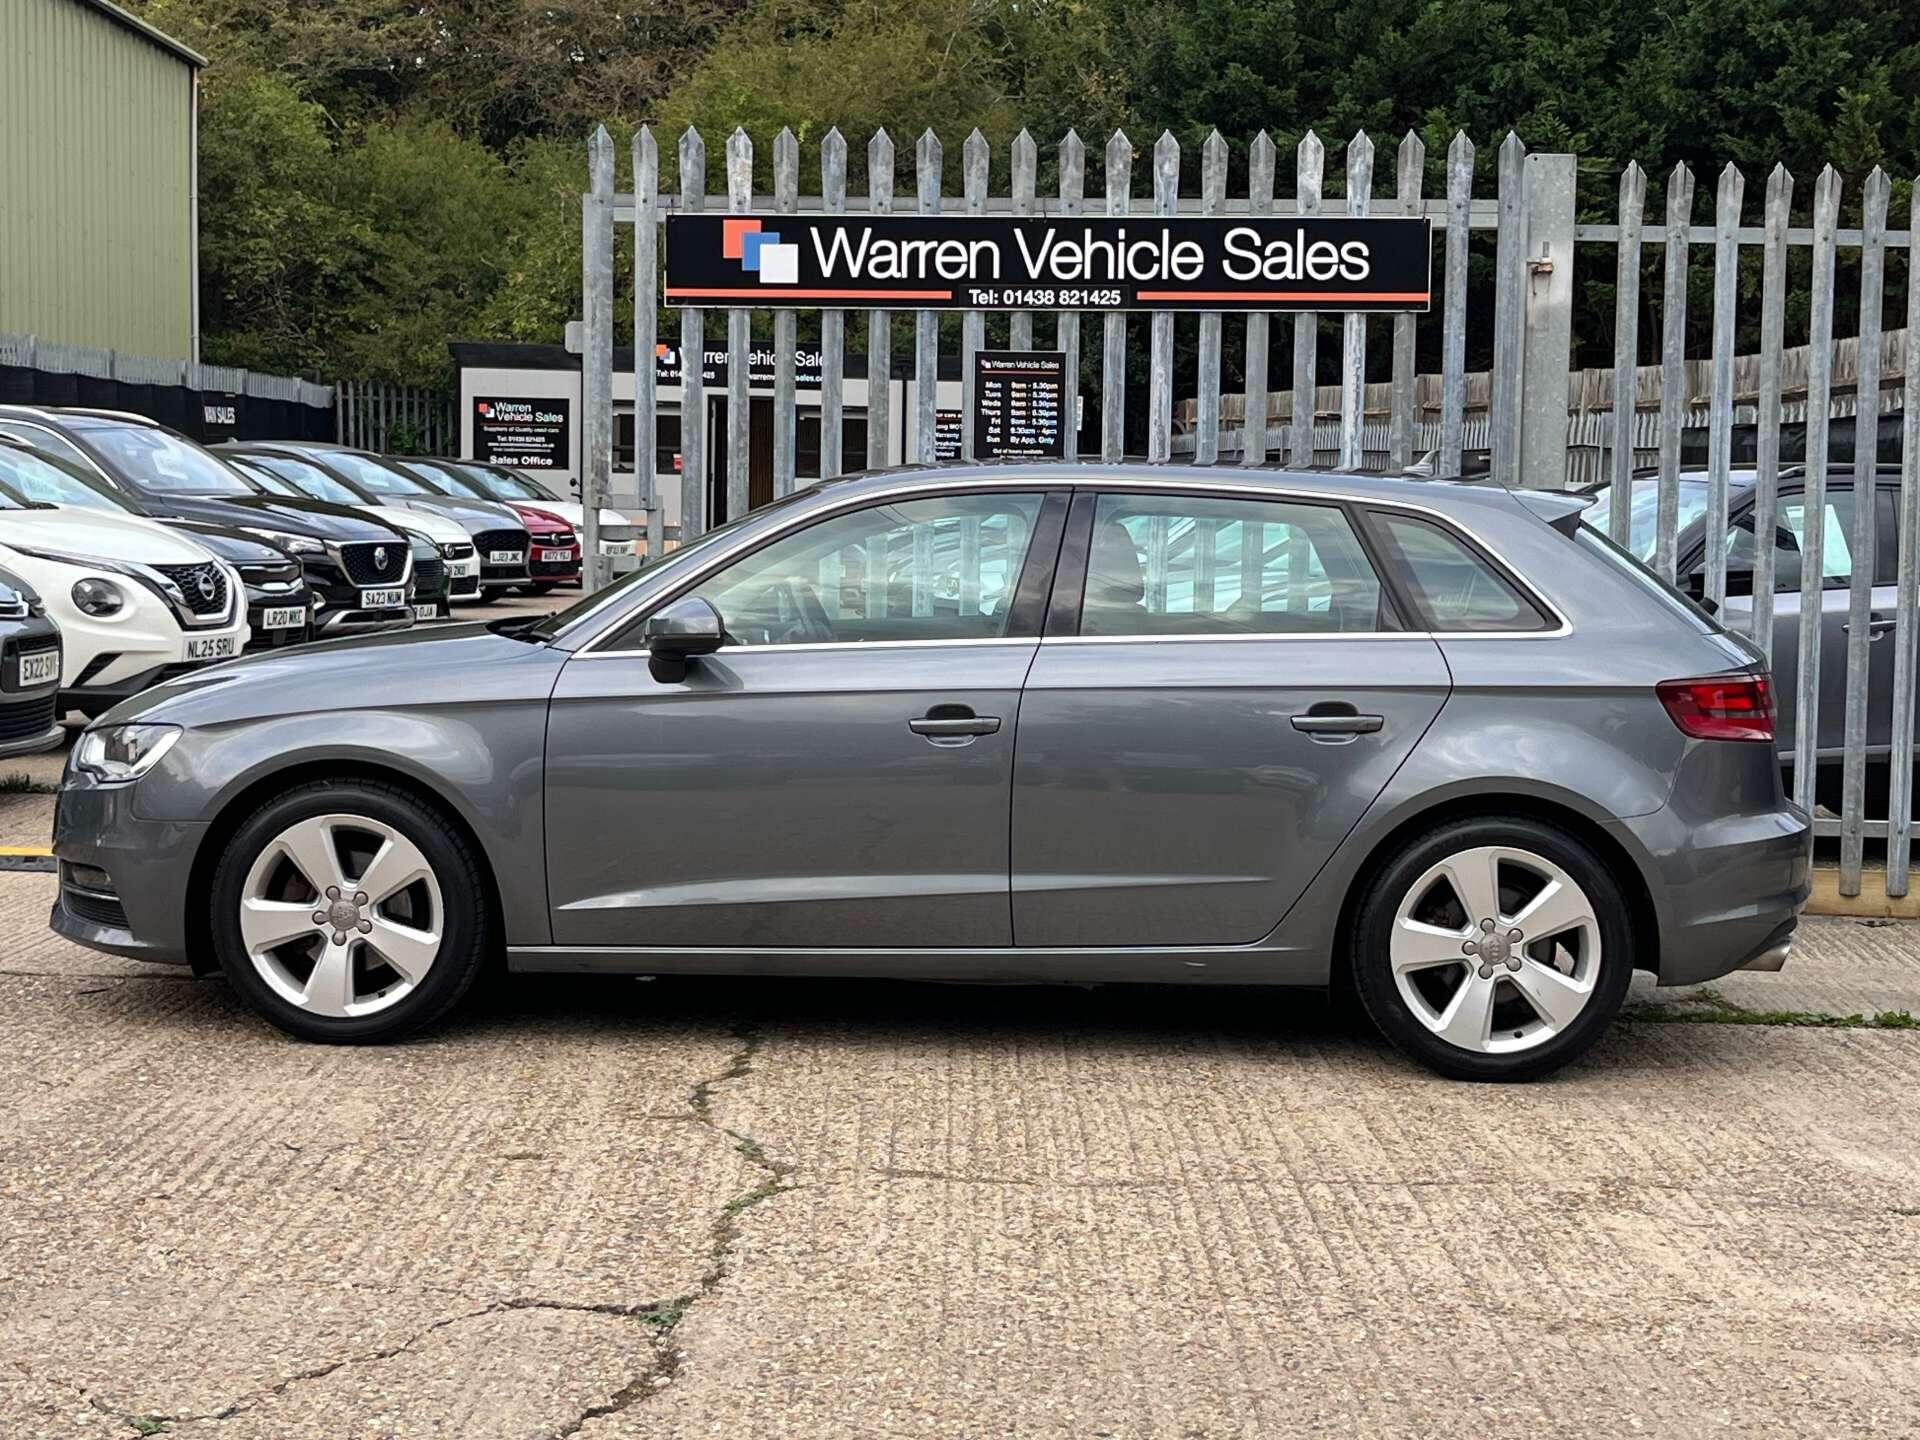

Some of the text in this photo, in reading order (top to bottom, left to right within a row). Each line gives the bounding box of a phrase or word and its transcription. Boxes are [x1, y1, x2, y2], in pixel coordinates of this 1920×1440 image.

[809, 226, 1371, 281] Warren Vehicle Sales
[968, 289, 1121, 306] Tel: 01438 821425
[991, 360, 1060, 369] Warren Vehicle Sales
[216, 406, 236, 424] SALES
[494, 402, 532, 412] Warren
[496, 412, 564, 422] Vehicle Sales
[489, 455, 553, 466] Sales Office
[366, 592, 386, 606] SA23
[266, 610, 288, 626] LR20
[188, 637, 235, 659] NL25 SRU
[24, 656, 44, 681] EX22
